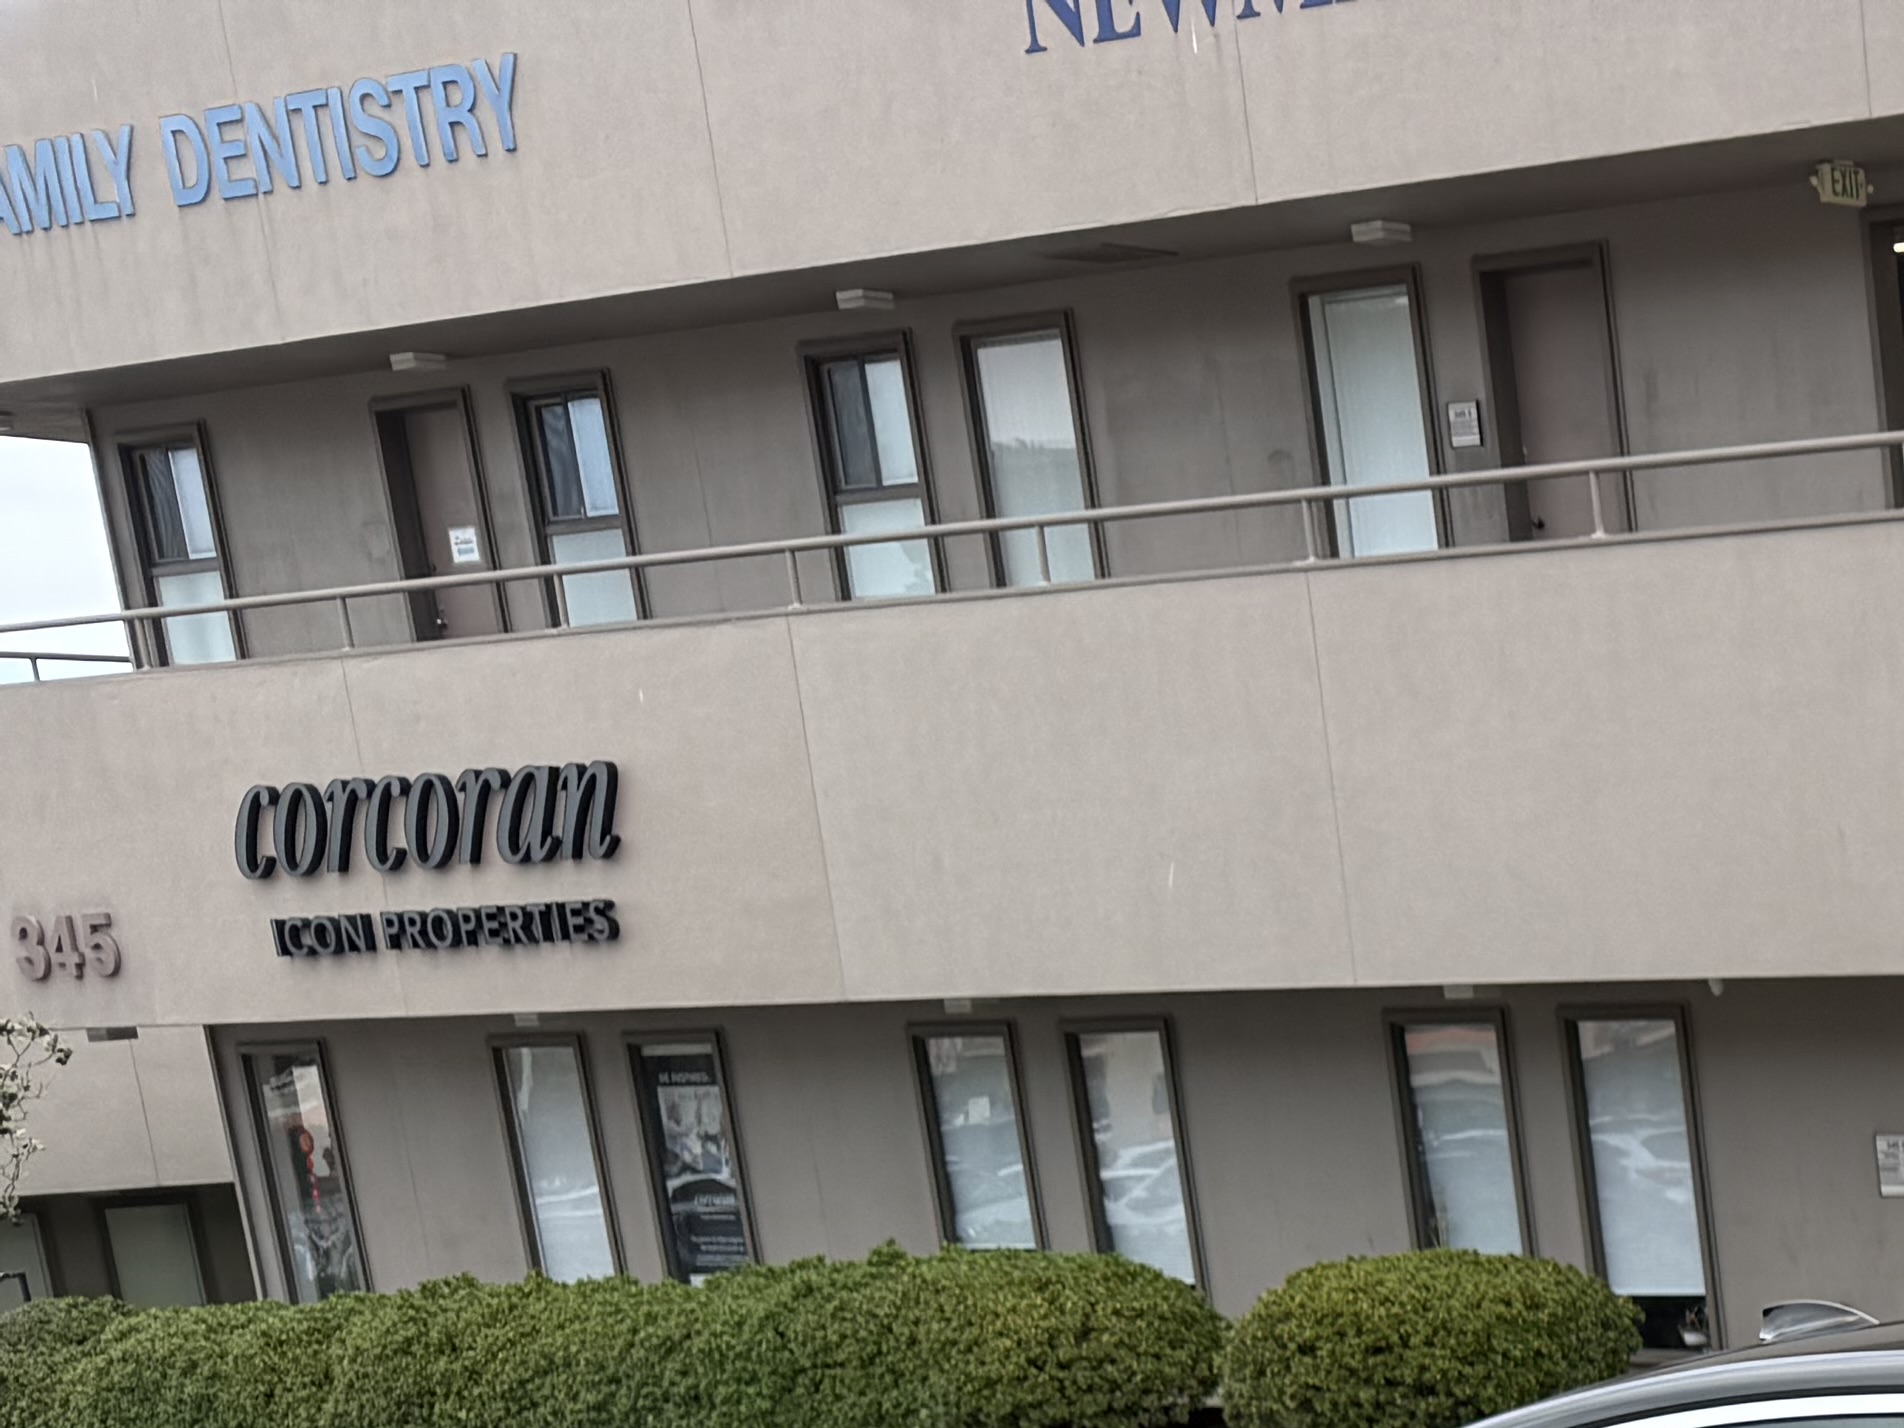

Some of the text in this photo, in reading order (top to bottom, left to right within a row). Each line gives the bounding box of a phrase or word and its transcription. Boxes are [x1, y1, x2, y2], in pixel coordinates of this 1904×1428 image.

[158, 52, 518, 208] DENTISTRY
[1831, 167, 1860, 200] EXIT
[234, 760, 621, 880] corcoran
[11, 912, 122, 982] 345
[270, 899, 620, 957] ICON PROPERTIES
